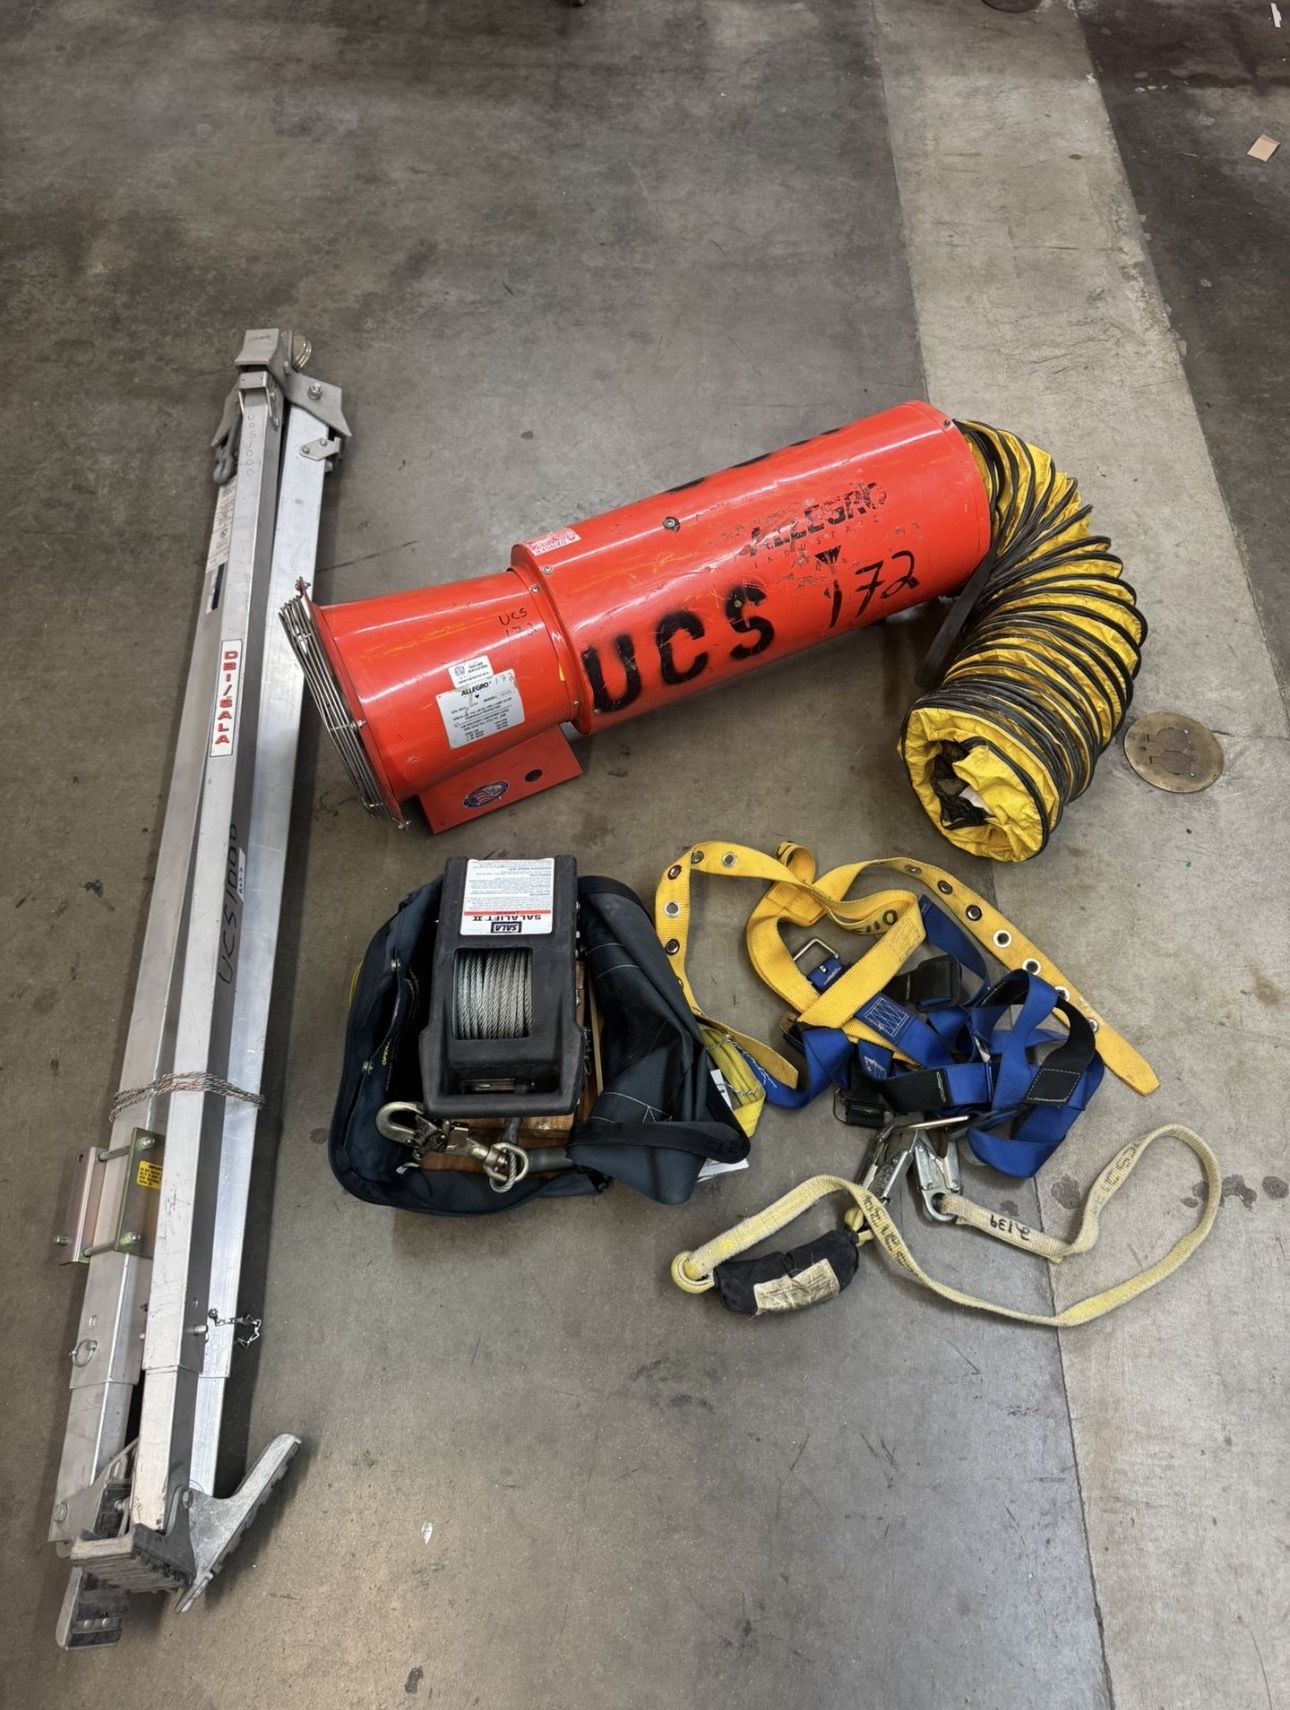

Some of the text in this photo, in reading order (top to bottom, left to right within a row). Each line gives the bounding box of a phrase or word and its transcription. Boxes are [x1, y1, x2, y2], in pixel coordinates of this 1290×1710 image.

[498, 607, 528, 626] UCS
[581, 550, 920, 713] UCS 172
[460, 680, 490, 697] ALLEGRO
[215, 651, 239, 745] DBI/SALA
[486, 914, 542, 922] SALALIFT
[495, 923, 518, 932] SALA
